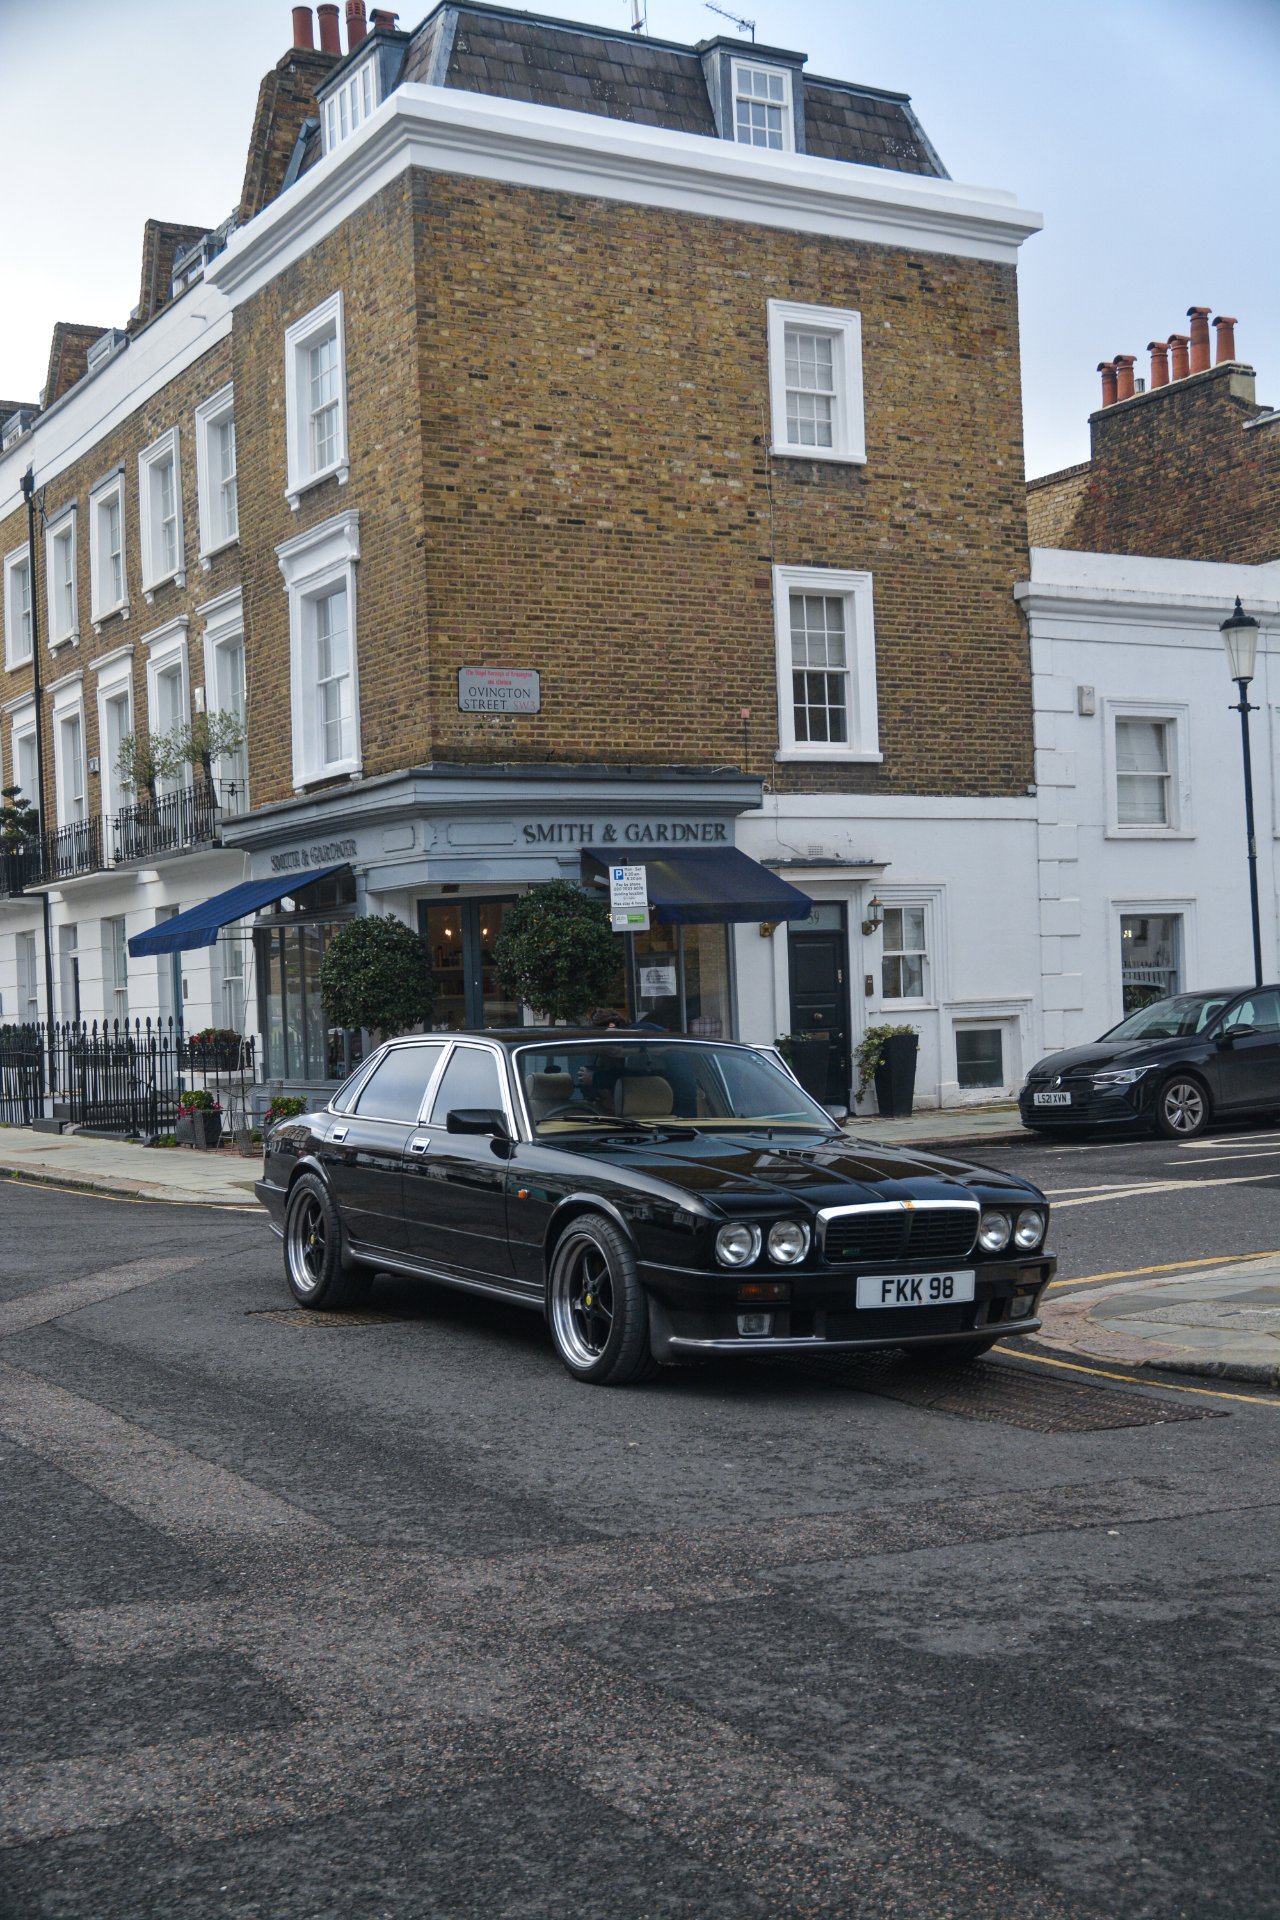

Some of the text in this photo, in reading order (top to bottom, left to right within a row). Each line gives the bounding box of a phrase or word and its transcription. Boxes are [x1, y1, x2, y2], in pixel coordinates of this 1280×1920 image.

[468, 686, 531, 698] OVINGTON
[464, 698, 507, 710] STREET
[523, 823, 727, 844] SMITH & GARDNER
[1037, 1094, 1066, 1103] LS21 XVN
[881, 1276, 954, 1302] FKK 98
